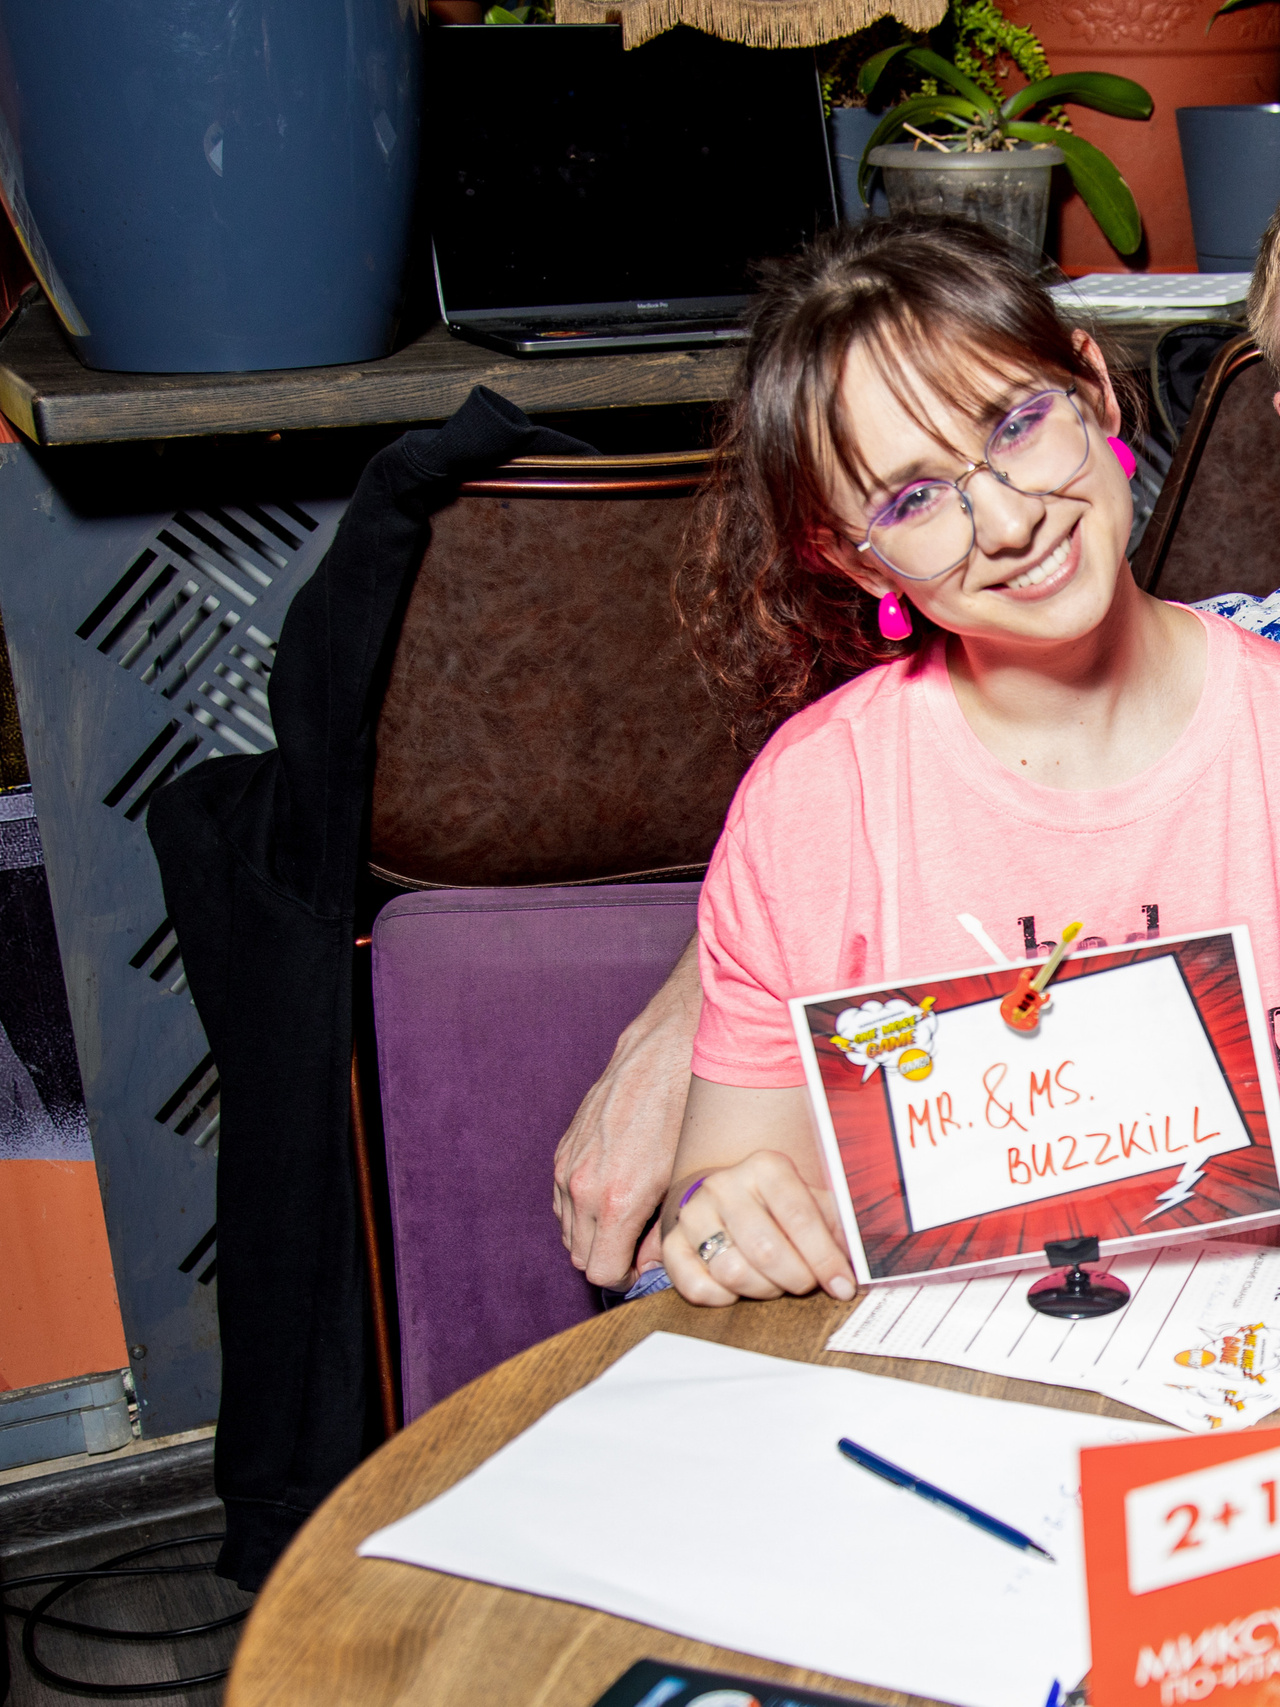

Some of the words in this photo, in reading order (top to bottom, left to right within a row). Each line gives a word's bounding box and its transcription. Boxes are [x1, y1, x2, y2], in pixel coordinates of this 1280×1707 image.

[907, 1090, 974, 1149] MR.
[981, 1062, 1029, 1132] &
[1029, 1059, 1095, 1117] MS.
[1163, 1478, 1278, 1558] 2+1
